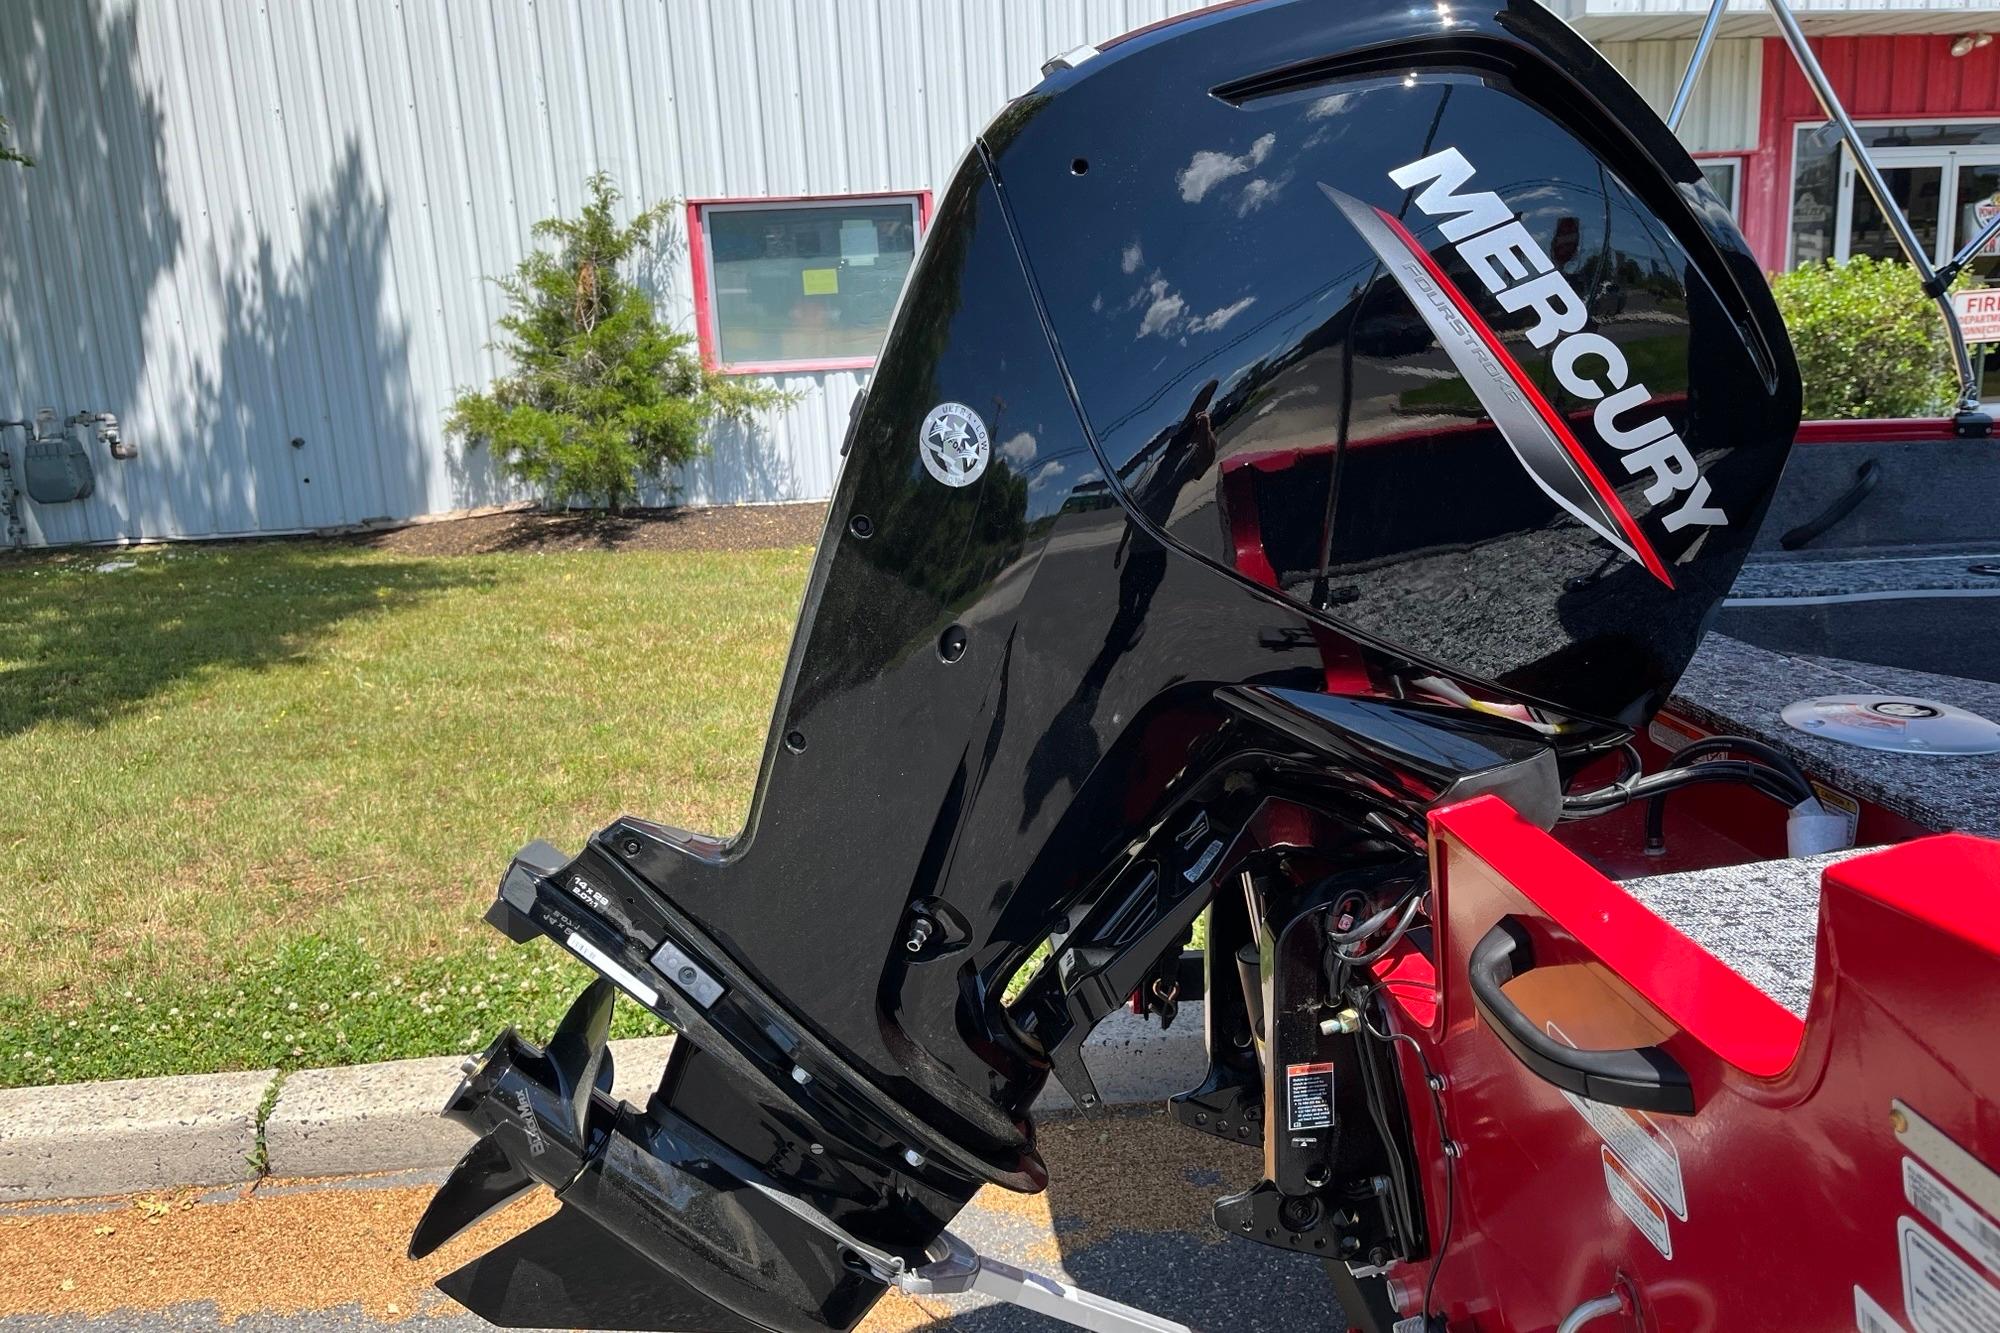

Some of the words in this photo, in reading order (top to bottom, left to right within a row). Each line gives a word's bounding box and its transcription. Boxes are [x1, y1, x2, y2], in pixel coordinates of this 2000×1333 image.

[1388, 146, 1729, 533] MERCURY
[942, 405, 972, 420] ULTRA
[975, 424, 988, 451] LOW
[574, 877, 588, 890] 14
